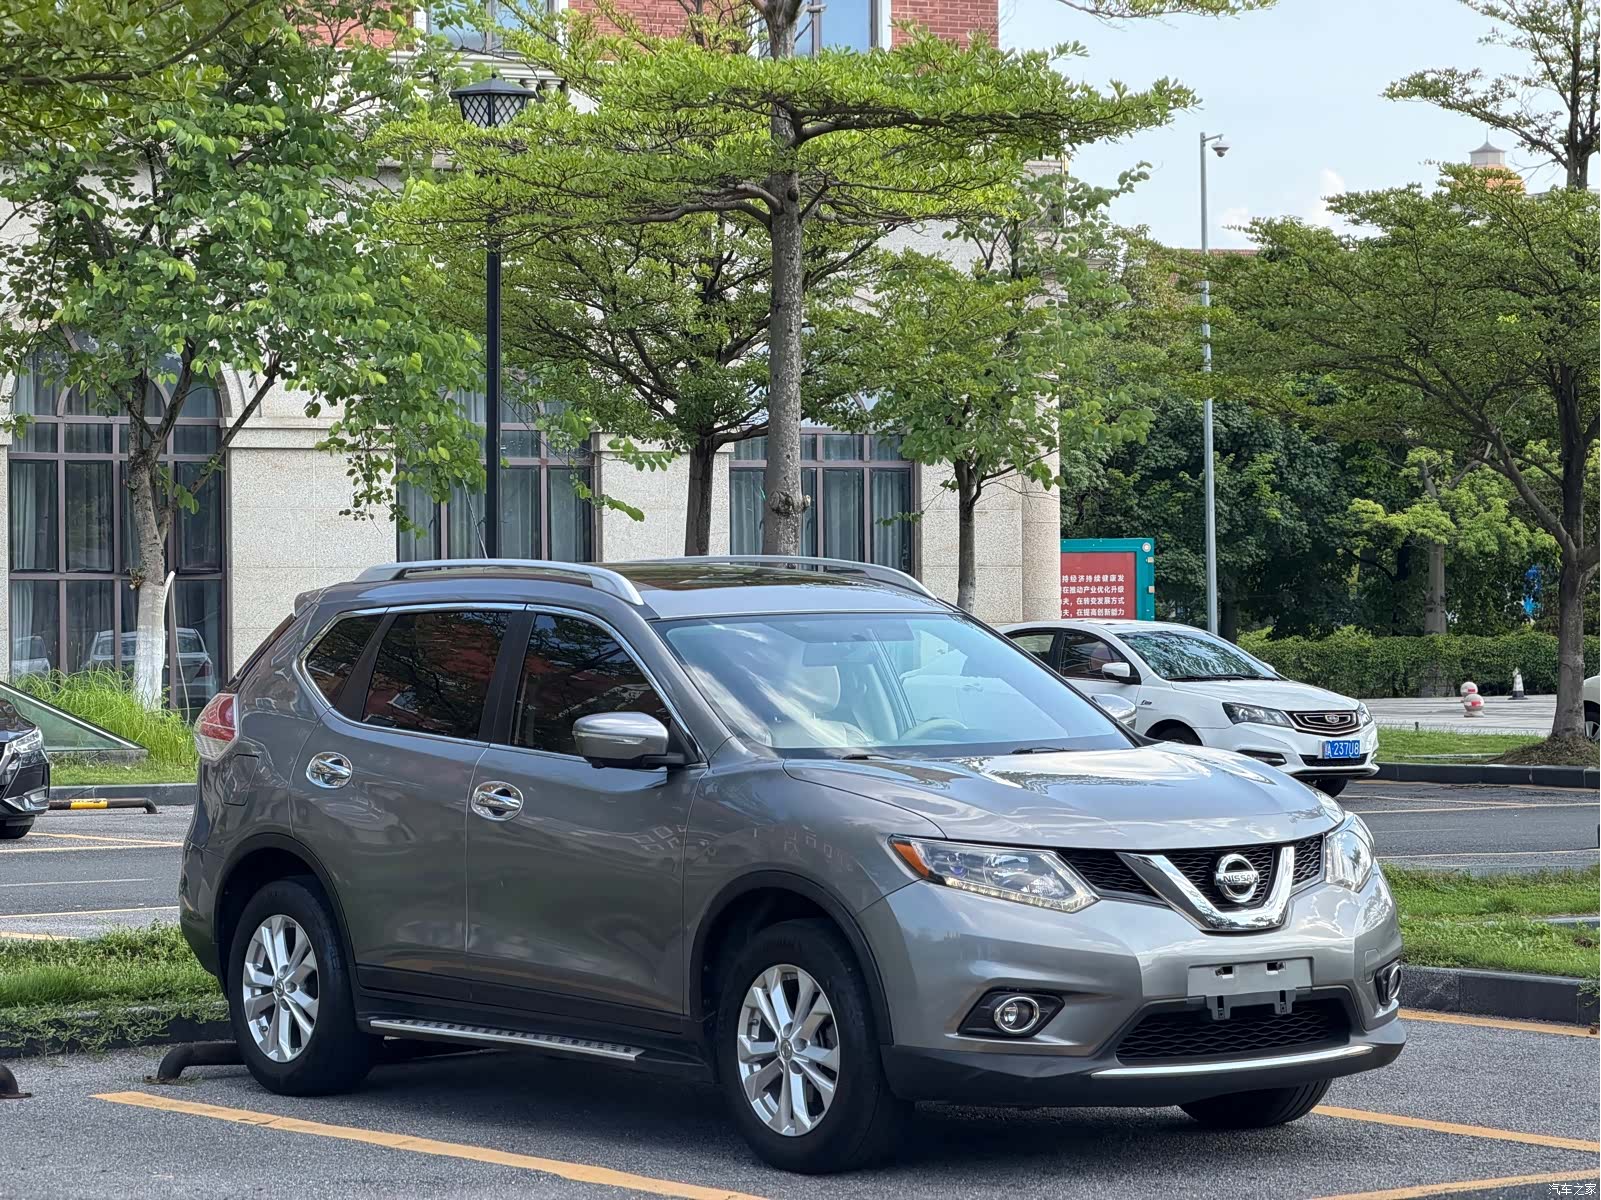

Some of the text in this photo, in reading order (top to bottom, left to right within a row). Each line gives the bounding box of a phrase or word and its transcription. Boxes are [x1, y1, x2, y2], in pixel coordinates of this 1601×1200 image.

[1062, 574, 1125, 583] 持经济持续健康发
[1061, 597, 1125, 606] 夫，在转变发展方式
[1061, 608, 1125, 618] 夫，在提高创新能力
[1223, 873, 1258, 882] NISSAN
